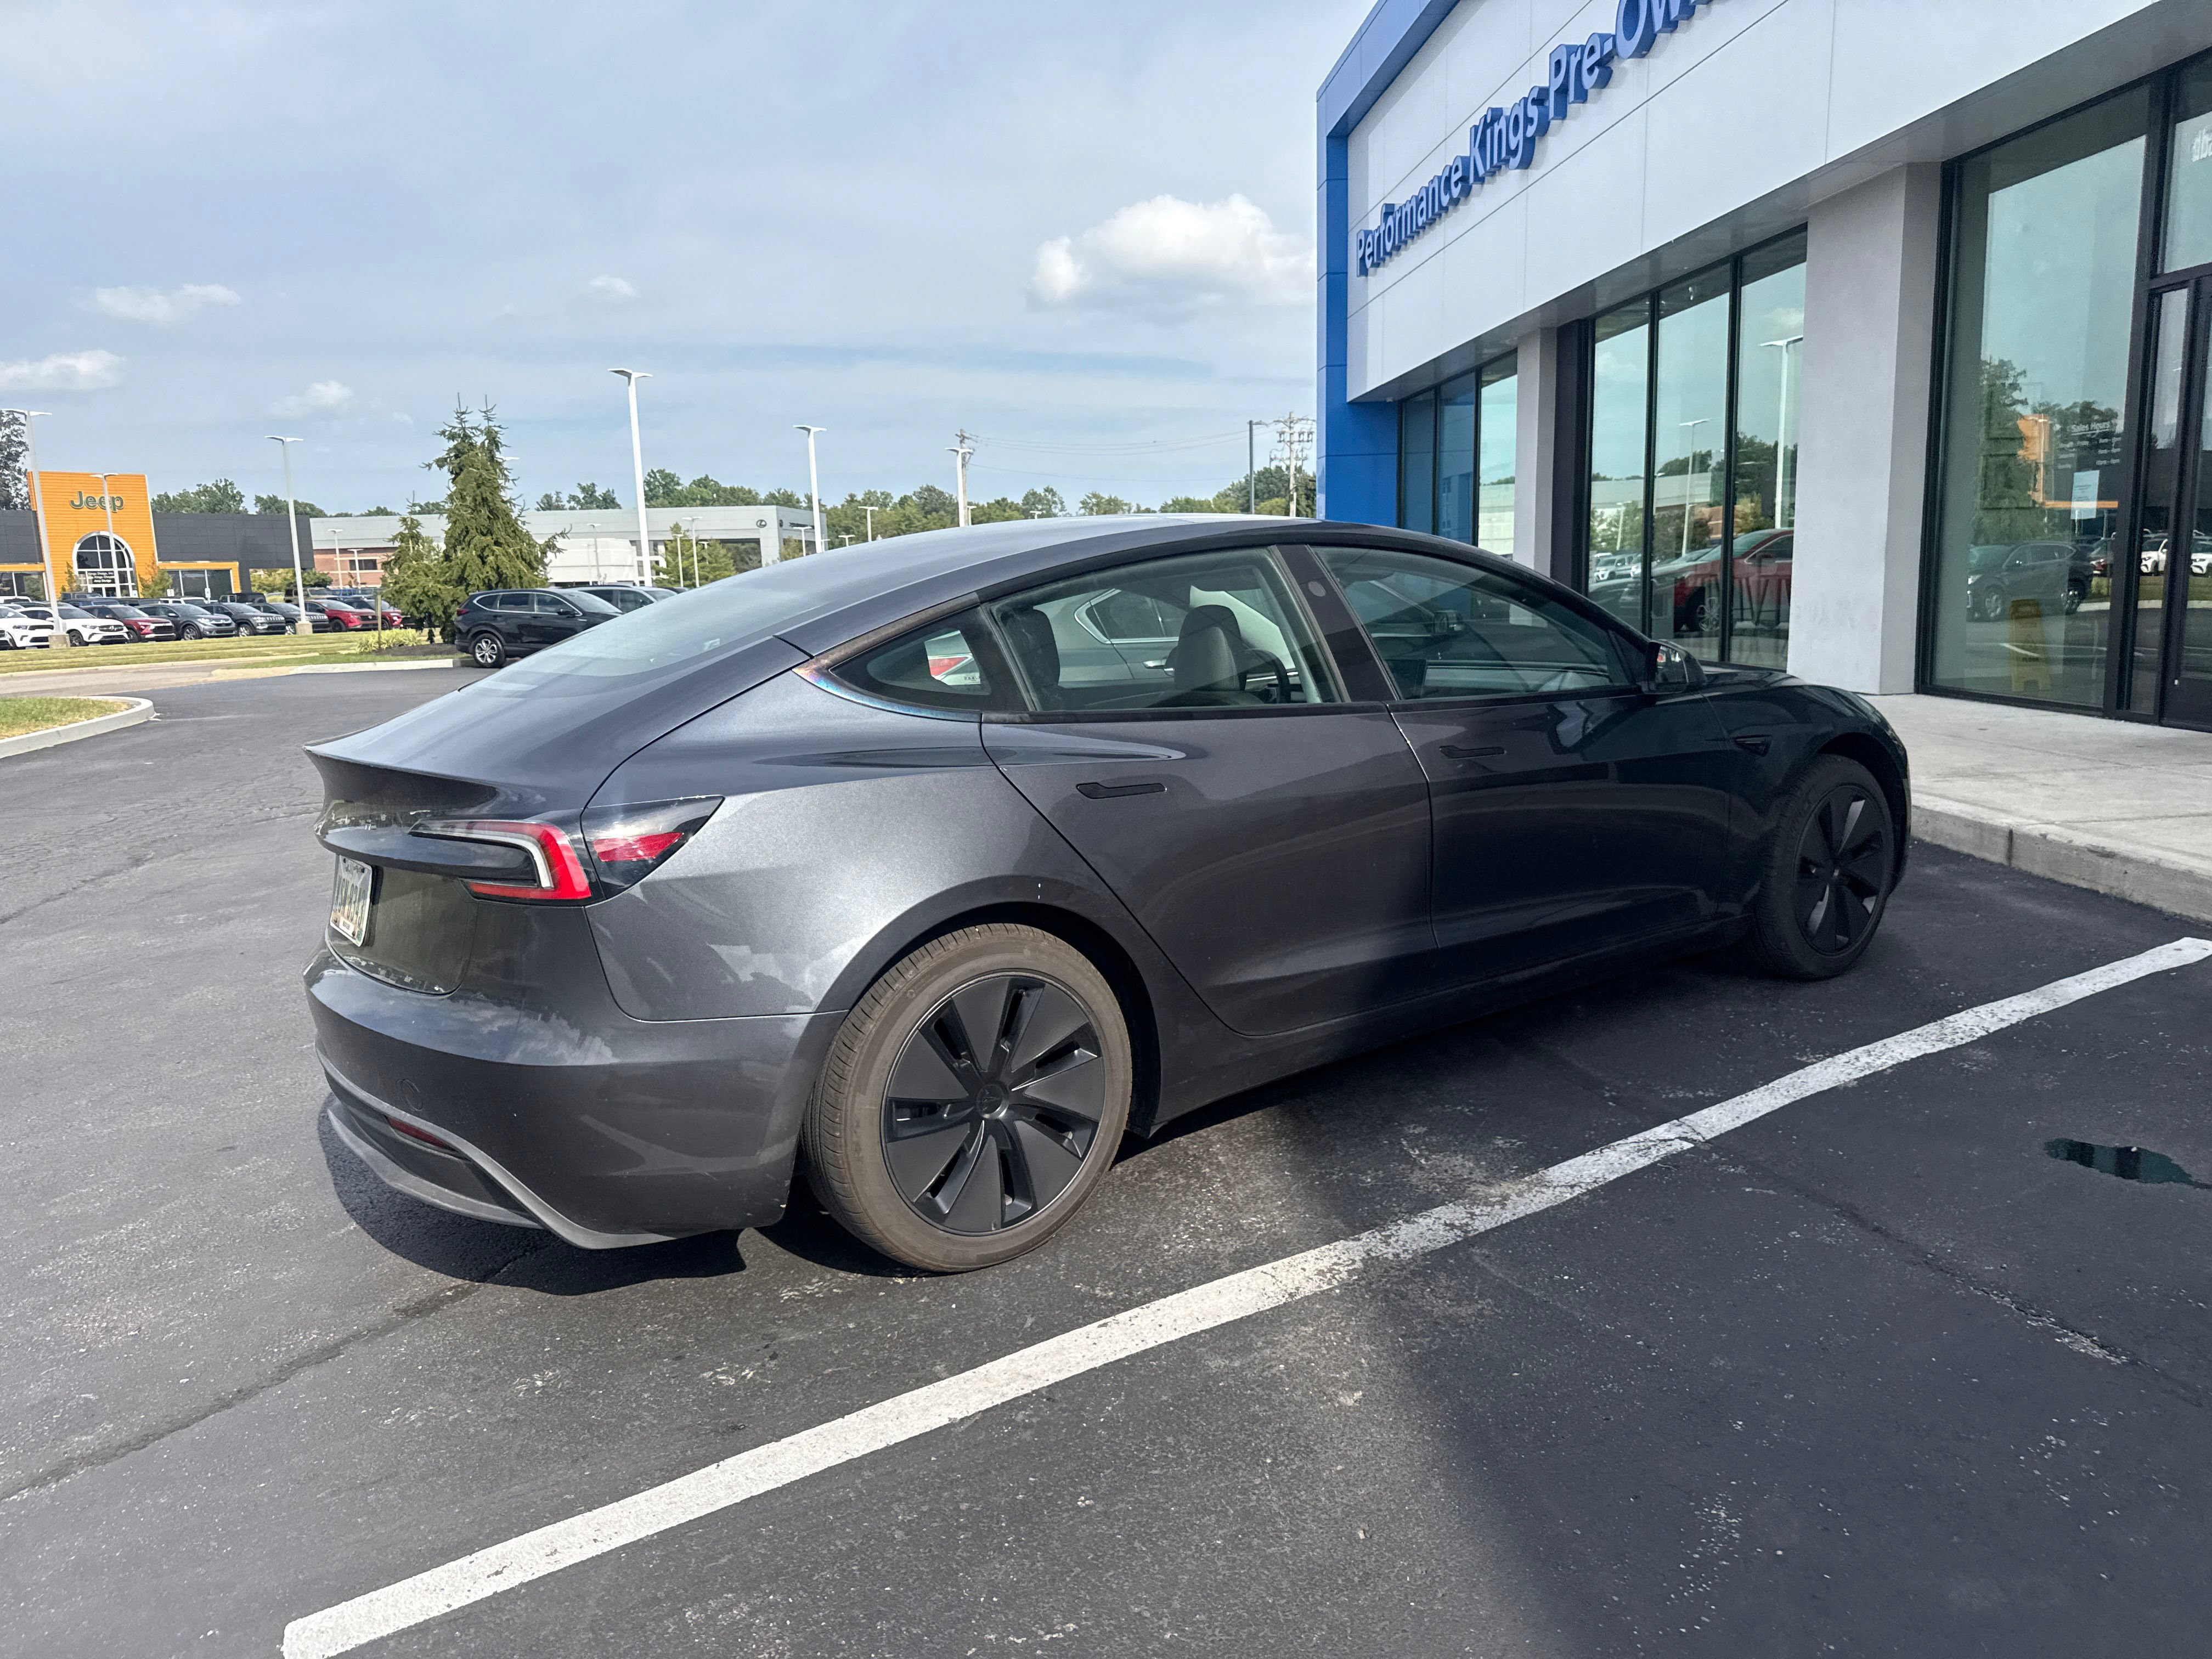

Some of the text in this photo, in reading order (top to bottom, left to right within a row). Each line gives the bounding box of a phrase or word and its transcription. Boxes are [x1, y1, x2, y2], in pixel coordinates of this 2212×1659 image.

[1357, 0, 1702, 277] Performance Kings Pre-Ow
[70, 491, 124, 512] Jeep
